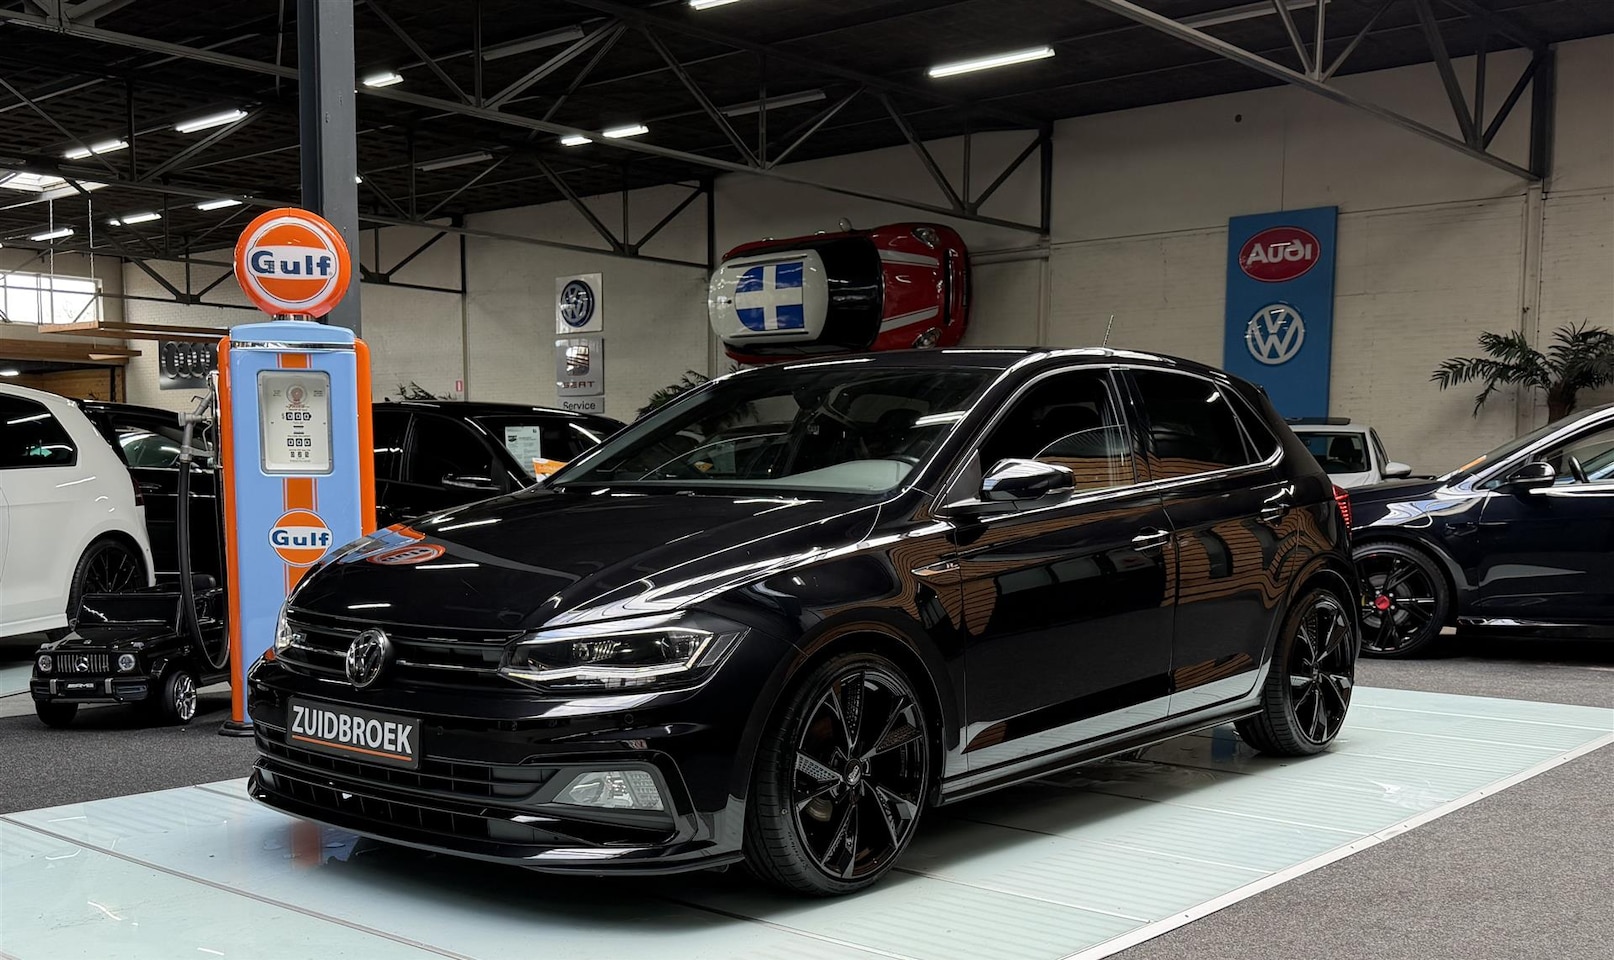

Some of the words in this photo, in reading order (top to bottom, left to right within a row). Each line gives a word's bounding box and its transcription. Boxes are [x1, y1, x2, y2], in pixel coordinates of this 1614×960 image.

[251, 250, 331, 276] Gulf
[563, 401, 596, 410] Service
[272, 529, 329, 546] Gulf
[291, 705, 413, 754] ZUIDBROEK
